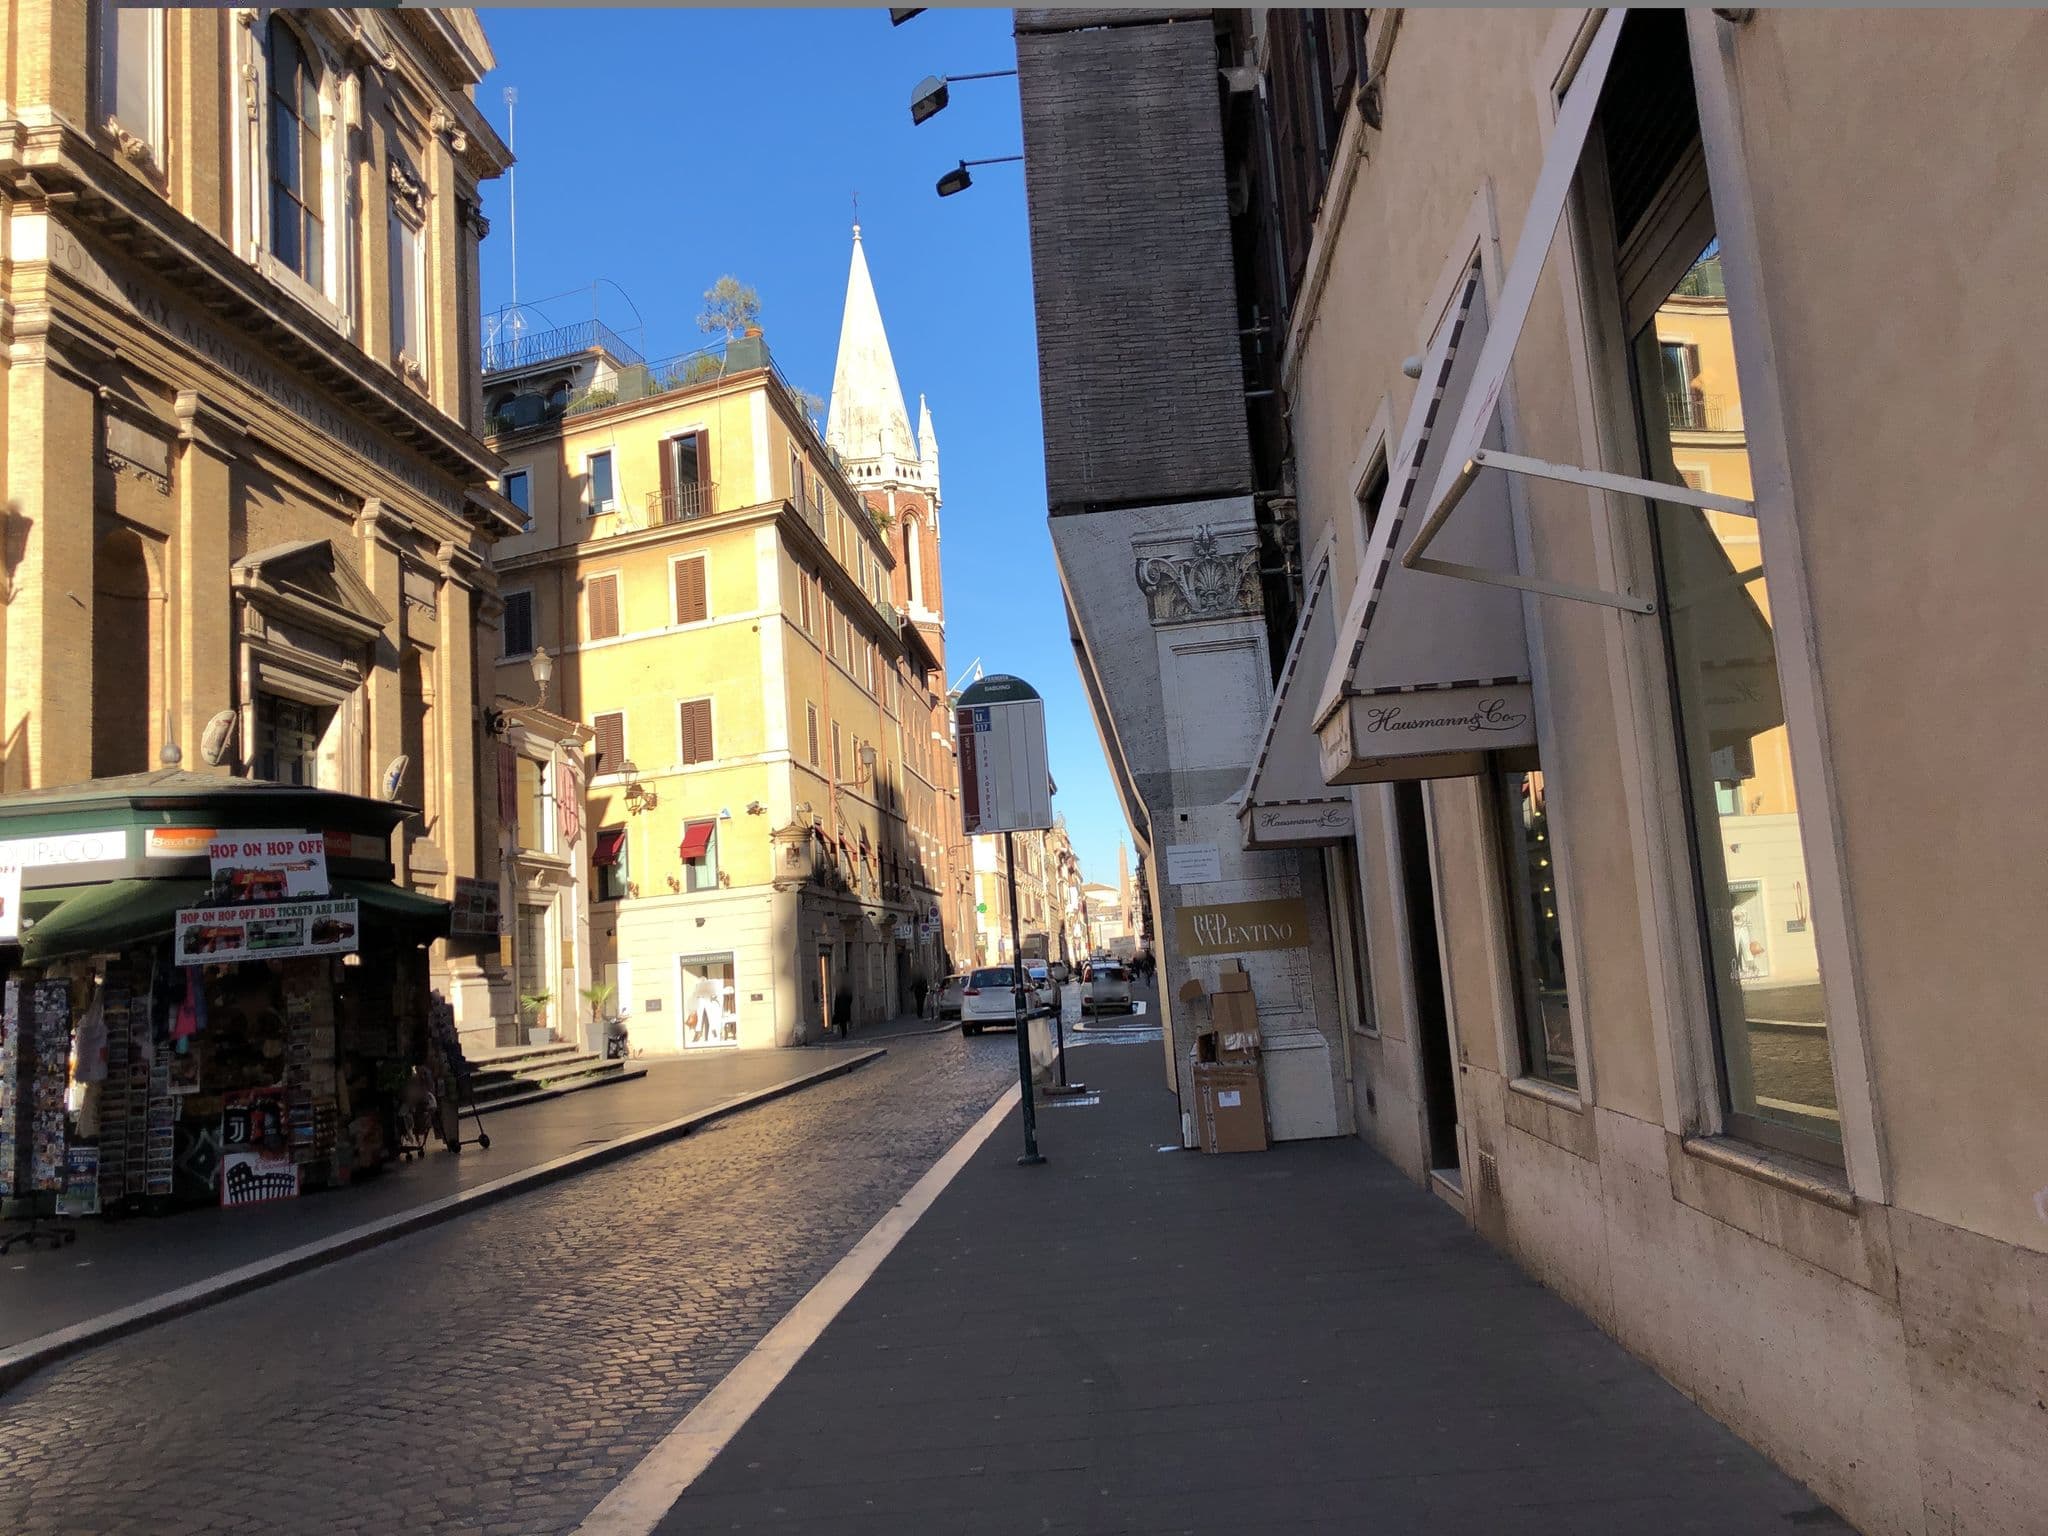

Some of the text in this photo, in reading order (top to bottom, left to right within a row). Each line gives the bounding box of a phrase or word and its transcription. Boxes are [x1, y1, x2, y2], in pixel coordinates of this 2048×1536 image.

[1367, 707, 1468, 733] Hausmann
[209, 843, 237, 859] HOP
[242, 842, 263, 857] ON
[266, 841, 294, 856] HOP
[298, 839, 323, 854] OFF
[180, 902, 357, 924] HOP ON HOP OFF BUS TICKETS ARE HERE
[1193, 913, 1227, 931] RED
[1193, 923, 1293, 946] VALENTINO
